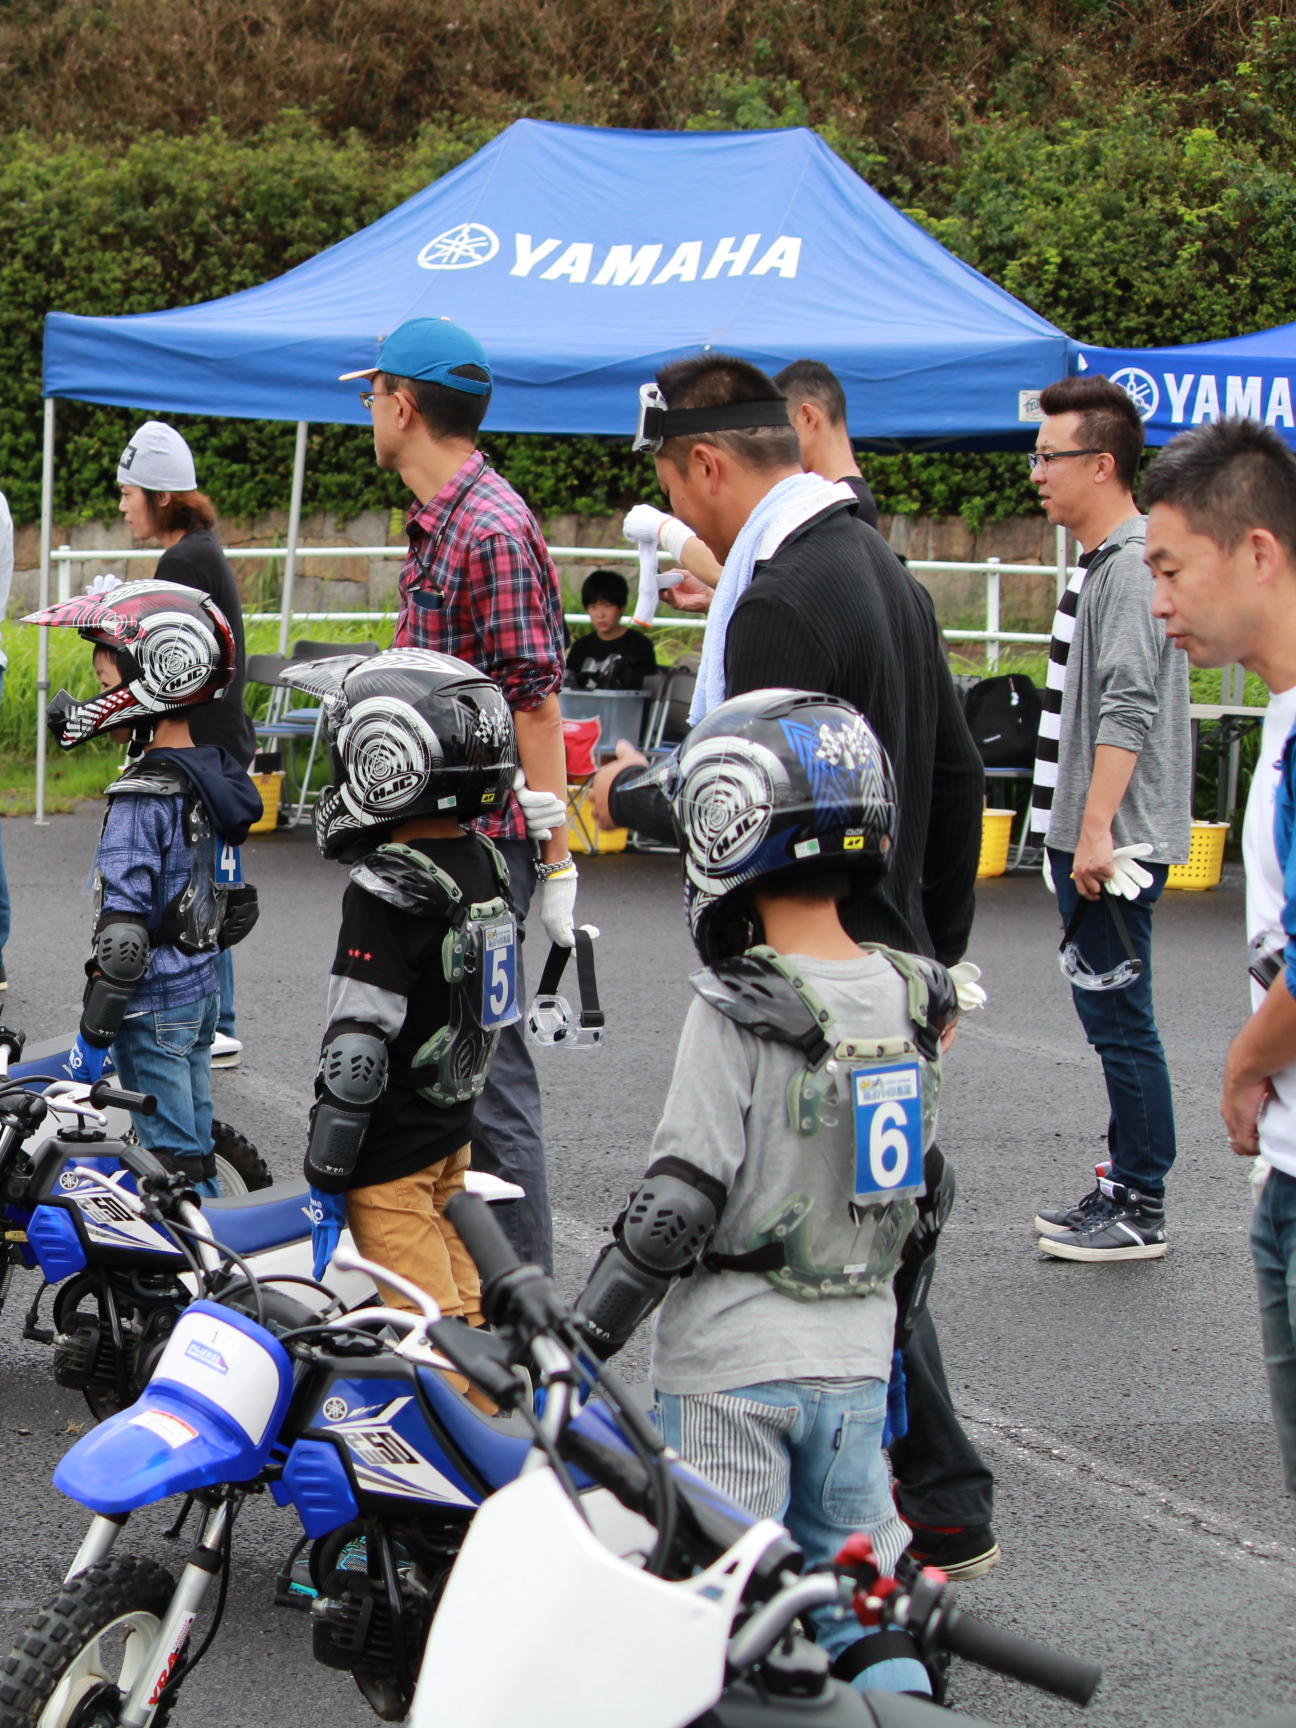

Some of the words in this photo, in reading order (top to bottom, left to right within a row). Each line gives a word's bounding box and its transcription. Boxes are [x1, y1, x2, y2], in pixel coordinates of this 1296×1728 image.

[509, 233, 802, 286] YAMAHA
[169, 668, 203, 691] HJC
[372, 775, 413, 801] HJC
[715, 809, 759, 857] HJC
[220, 844, 236, 881] 4
[490, 947, 509, 1015] 5
[869, 1101, 909, 1188] 6
